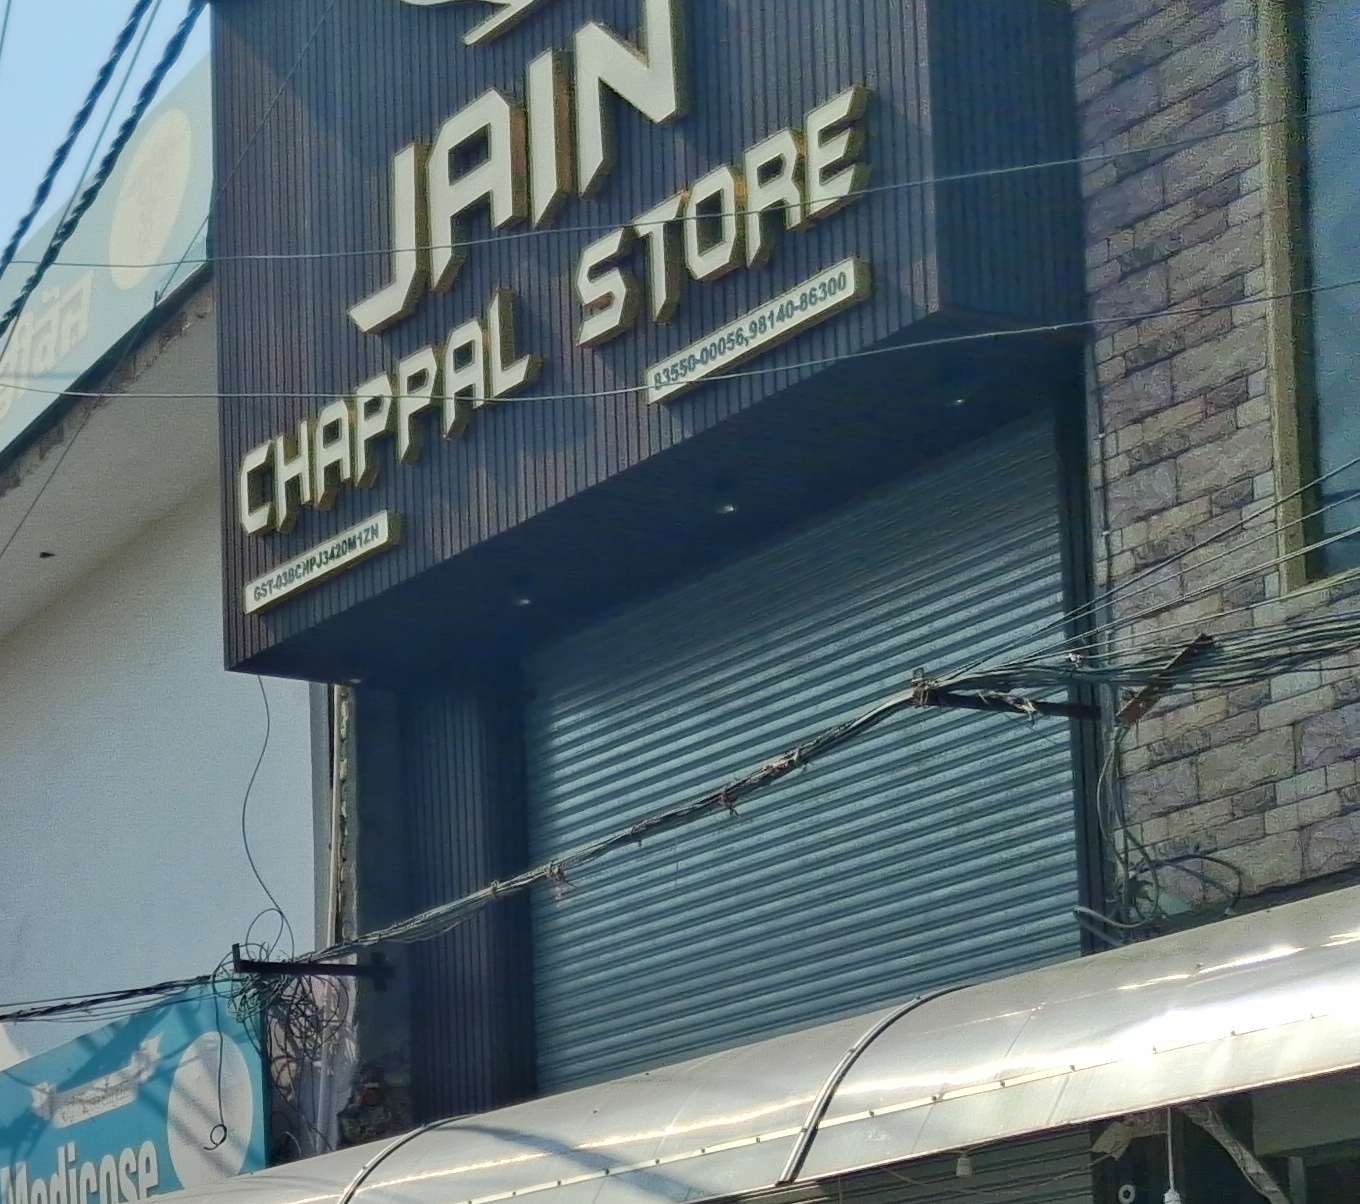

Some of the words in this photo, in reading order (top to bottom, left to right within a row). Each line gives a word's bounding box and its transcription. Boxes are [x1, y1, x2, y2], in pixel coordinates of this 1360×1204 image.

[240, 288, 542, 535] CHAPPAL
[577, 83, 872, 347] STORE
[348, 0, 682, 334] JAIN
